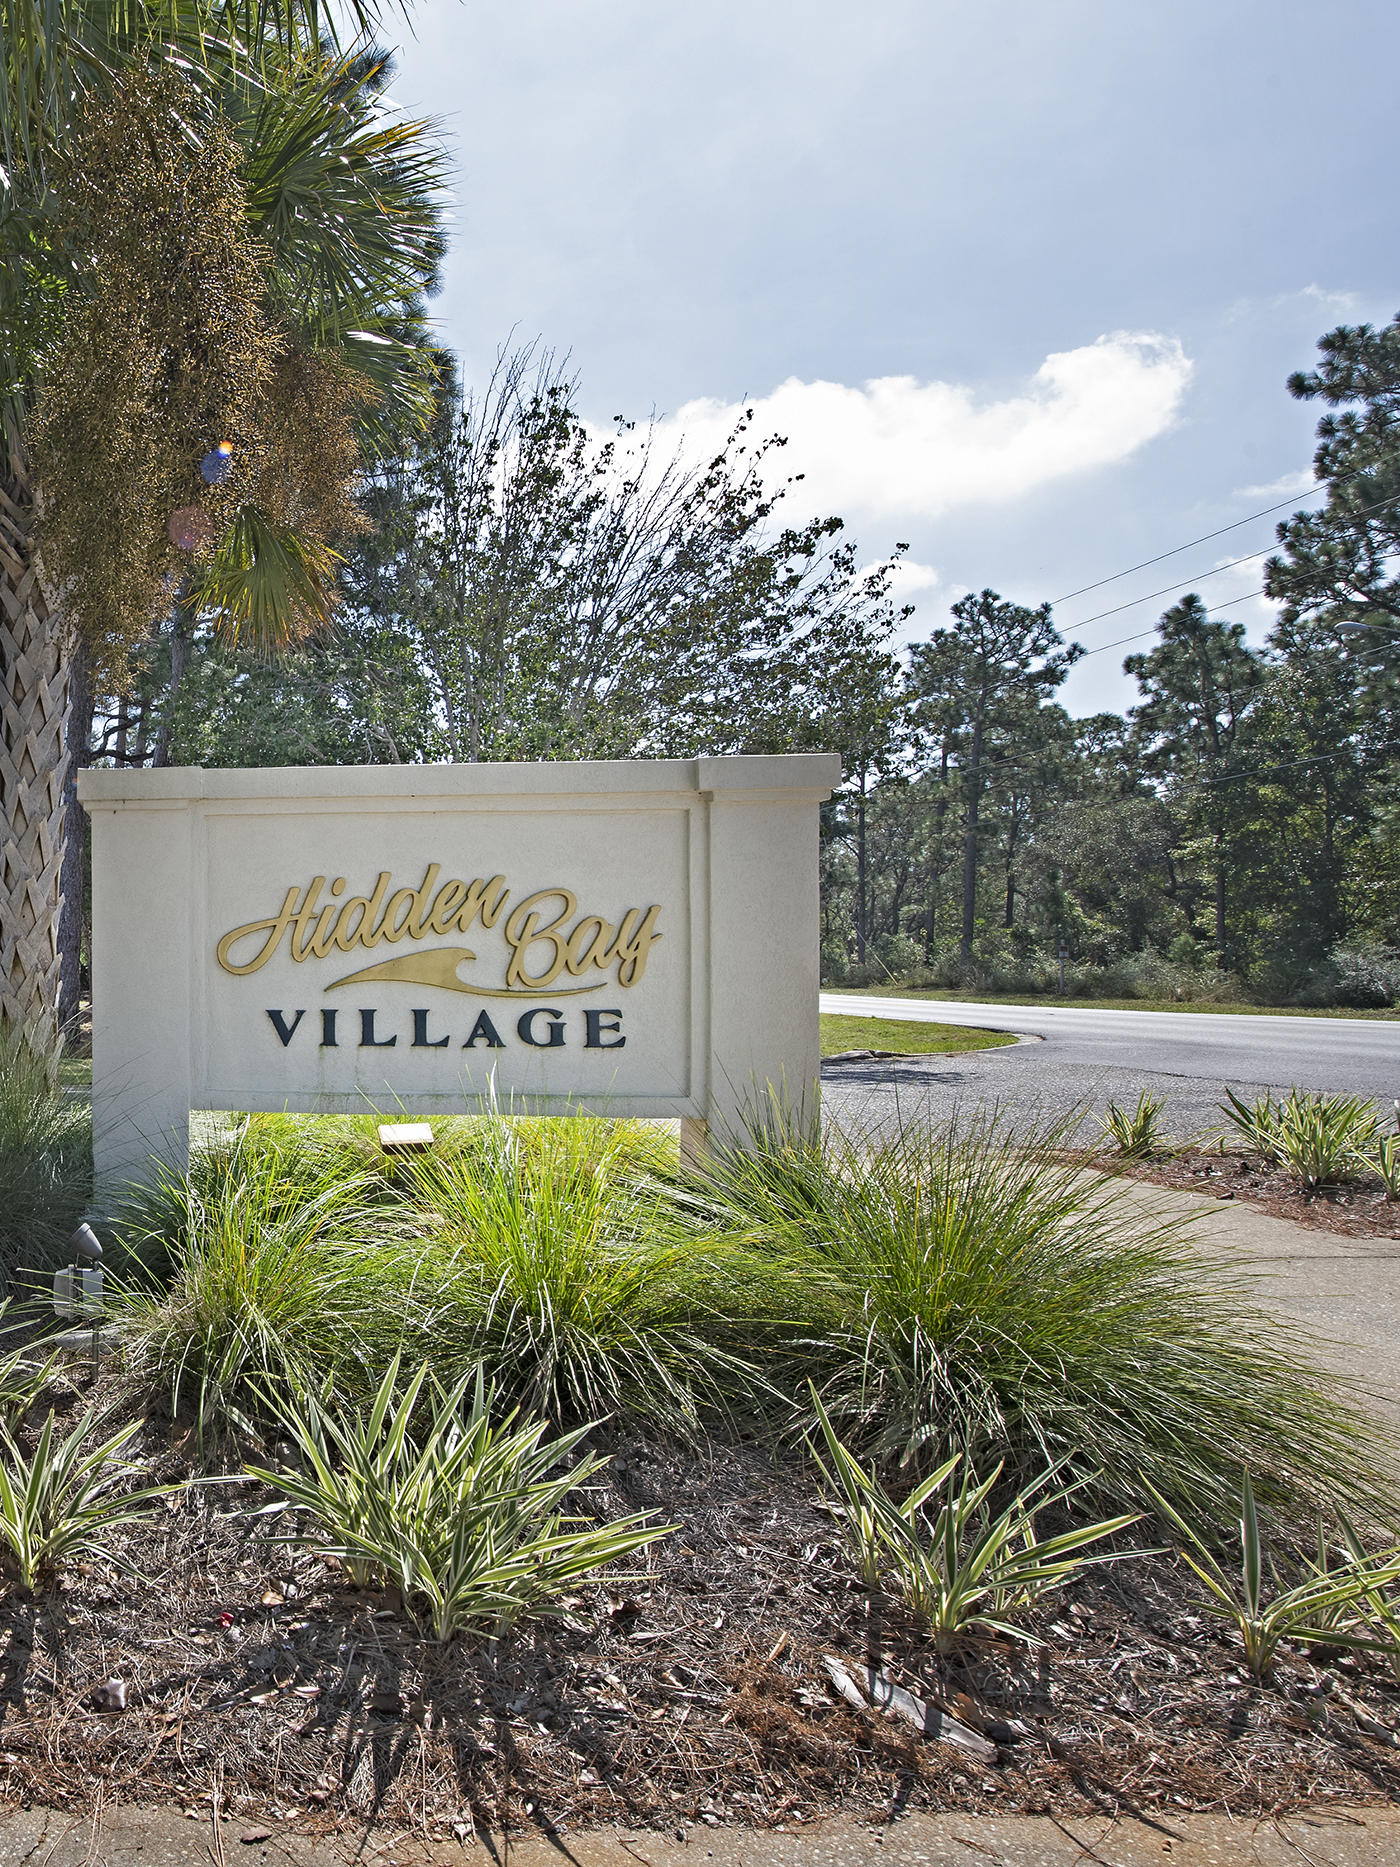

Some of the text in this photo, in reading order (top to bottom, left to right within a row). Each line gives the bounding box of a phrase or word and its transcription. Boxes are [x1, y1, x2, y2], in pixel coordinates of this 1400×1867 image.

[217, 863, 664, 988] Hidden Bay
[265, 1007, 627, 1049] VILLAGE
